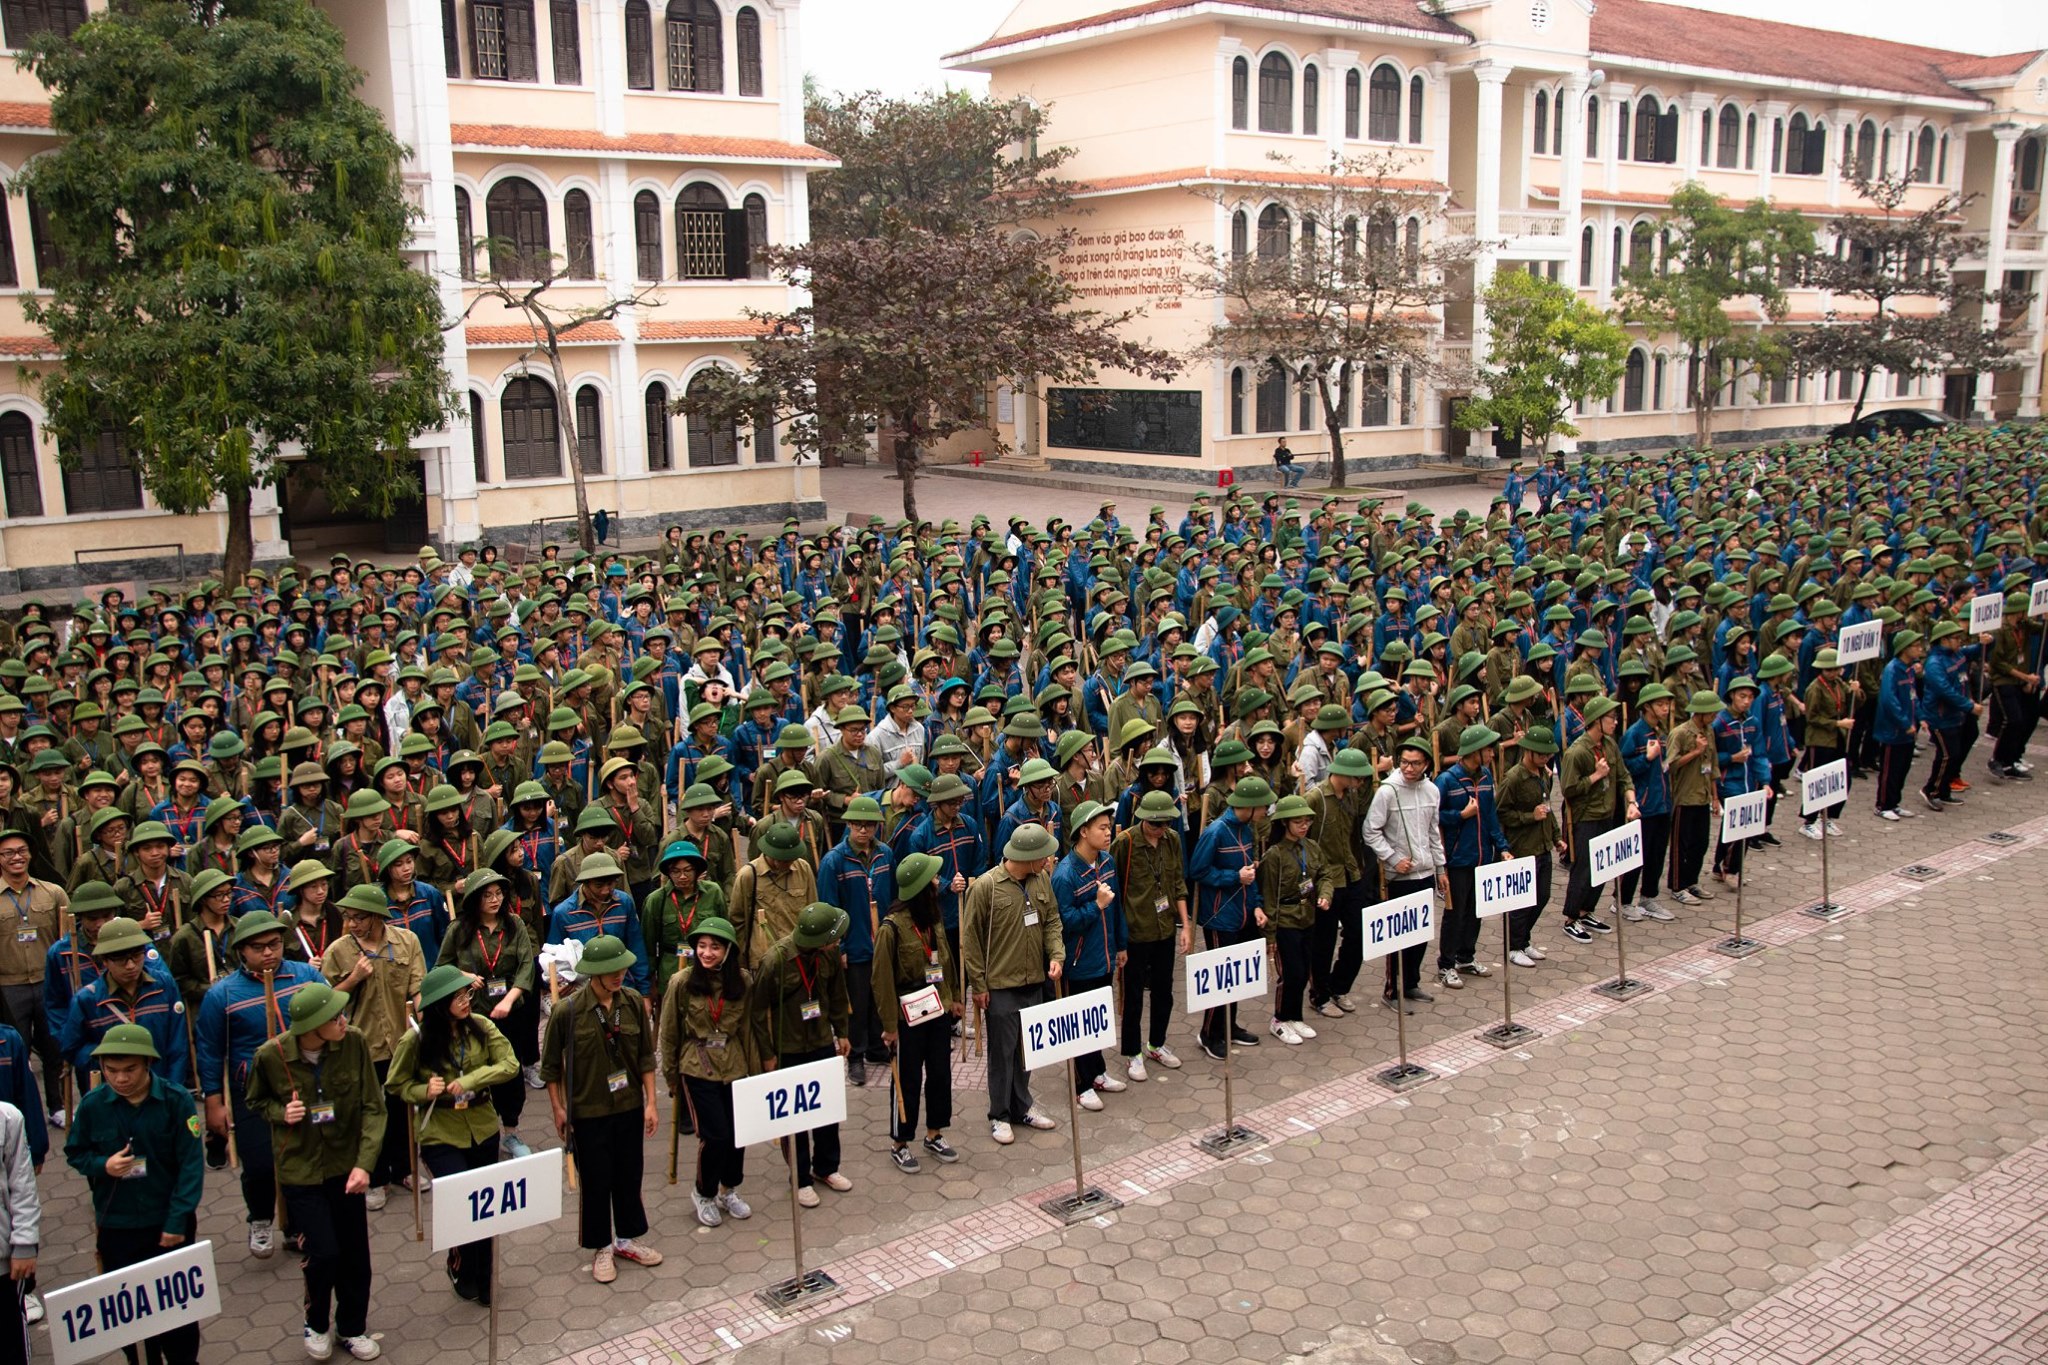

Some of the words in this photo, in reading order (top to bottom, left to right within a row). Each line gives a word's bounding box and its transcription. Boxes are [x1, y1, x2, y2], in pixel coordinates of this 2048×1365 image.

[1841, 771, 1845, 789] 2
[1729, 808, 1736, 829] 12
[1740, 804, 1753, 829] ĐỊA
[1754, 798, 1764, 823] LÝ
[1595, 849, 1604, 871] 12
[1615, 836, 1632, 863] ANH
[1634, 833, 1640, 855] 2
[1482, 878, 1493, 902] 12
[1370, 918, 1384, 944] 12
[1386, 905, 1418, 939] TOÁN
[1422, 904, 1430, 928] 2
[1194, 968, 1210, 996] 12
[1215, 956, 1242, 993] VẬT
[1245, 950, 1261, 984] LÝ
[1028, 1022, 1044, 1052] 12
[1048, 1012, 1080, 1047] SINH
[1082, 1003, 1109, 1038] HỌC
[765, 1088, 789, 1121] 12
[794, 1080, 822, 1115] A2
[468, 1186, 495, 1223] 12
[500, 1177, 527, 1214] A1
[62, 1303, 97, 1344] 12
[99, 1282, 153, 1331] HÓA
[155, 1265, 205, 1311] HỌC
